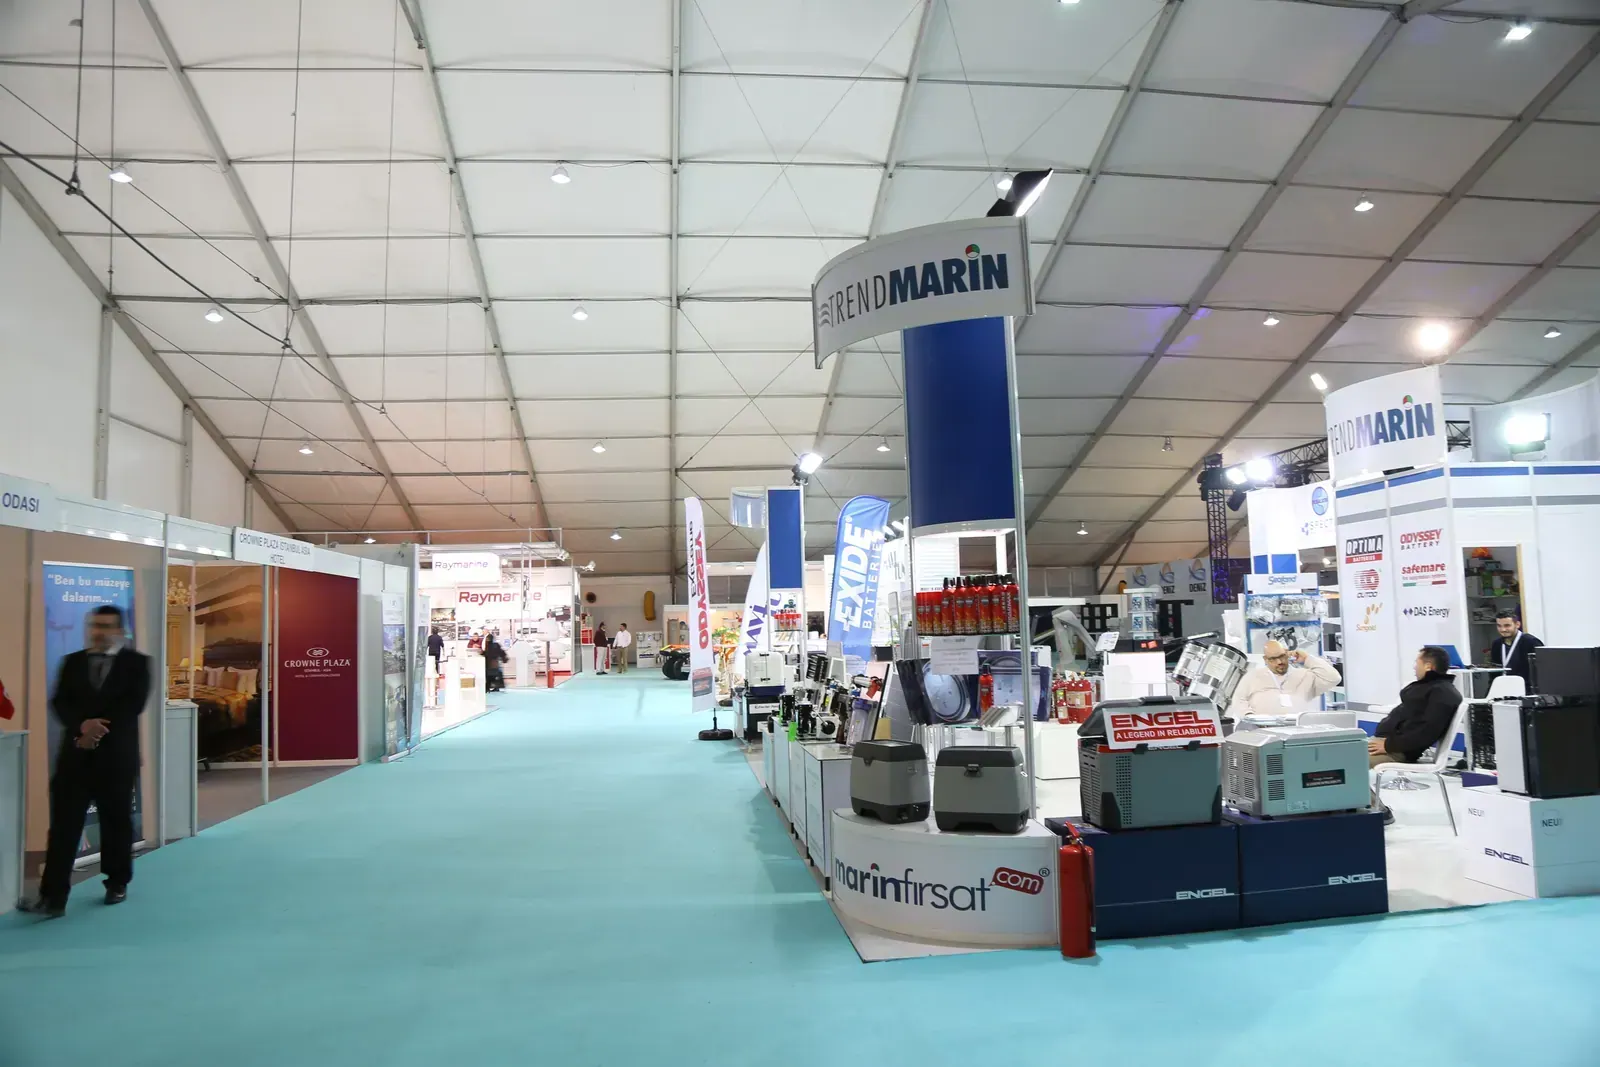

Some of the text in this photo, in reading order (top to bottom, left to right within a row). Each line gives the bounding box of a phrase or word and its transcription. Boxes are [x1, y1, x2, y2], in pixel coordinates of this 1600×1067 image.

[2, 492, 40, 513] ODASI
[240, 532, 263, 548] CROWNE
[263, 537, 280, 550] PLAZA
[1400, 529, 1442, 544] ODYSSEY
[1346, 537, 1382, 555] OPTIMA
[1400, 541, 1440, 551] BATTERY
[269, 553, 286, 565] HOTEL
[434, 561, 488, 571] Raymarine
[1401, 563, 1446, 574] safemare
[78, 576, 91, 586] bu
[834, 523, 873, 631] EXIDE
[862, 535, 884, 629] BATTERIE
[1413, 606, 1450, 618] DAS Energy
[284, 659, 351, 668] CROWNE PLAZA
[1110, 711, 1213, 728] ENGEL
[1124, 731, 1155, 739] LEGEND
[1157, 729, 1165, 737] IN
[1167, 727, 1213, 737] RELIABILITY
[1484, 847, 1530, 866] ENGEL
[1328, 872, 1384, 885] ENGEL
[1176, 887, 1236, 900] ENGEL
